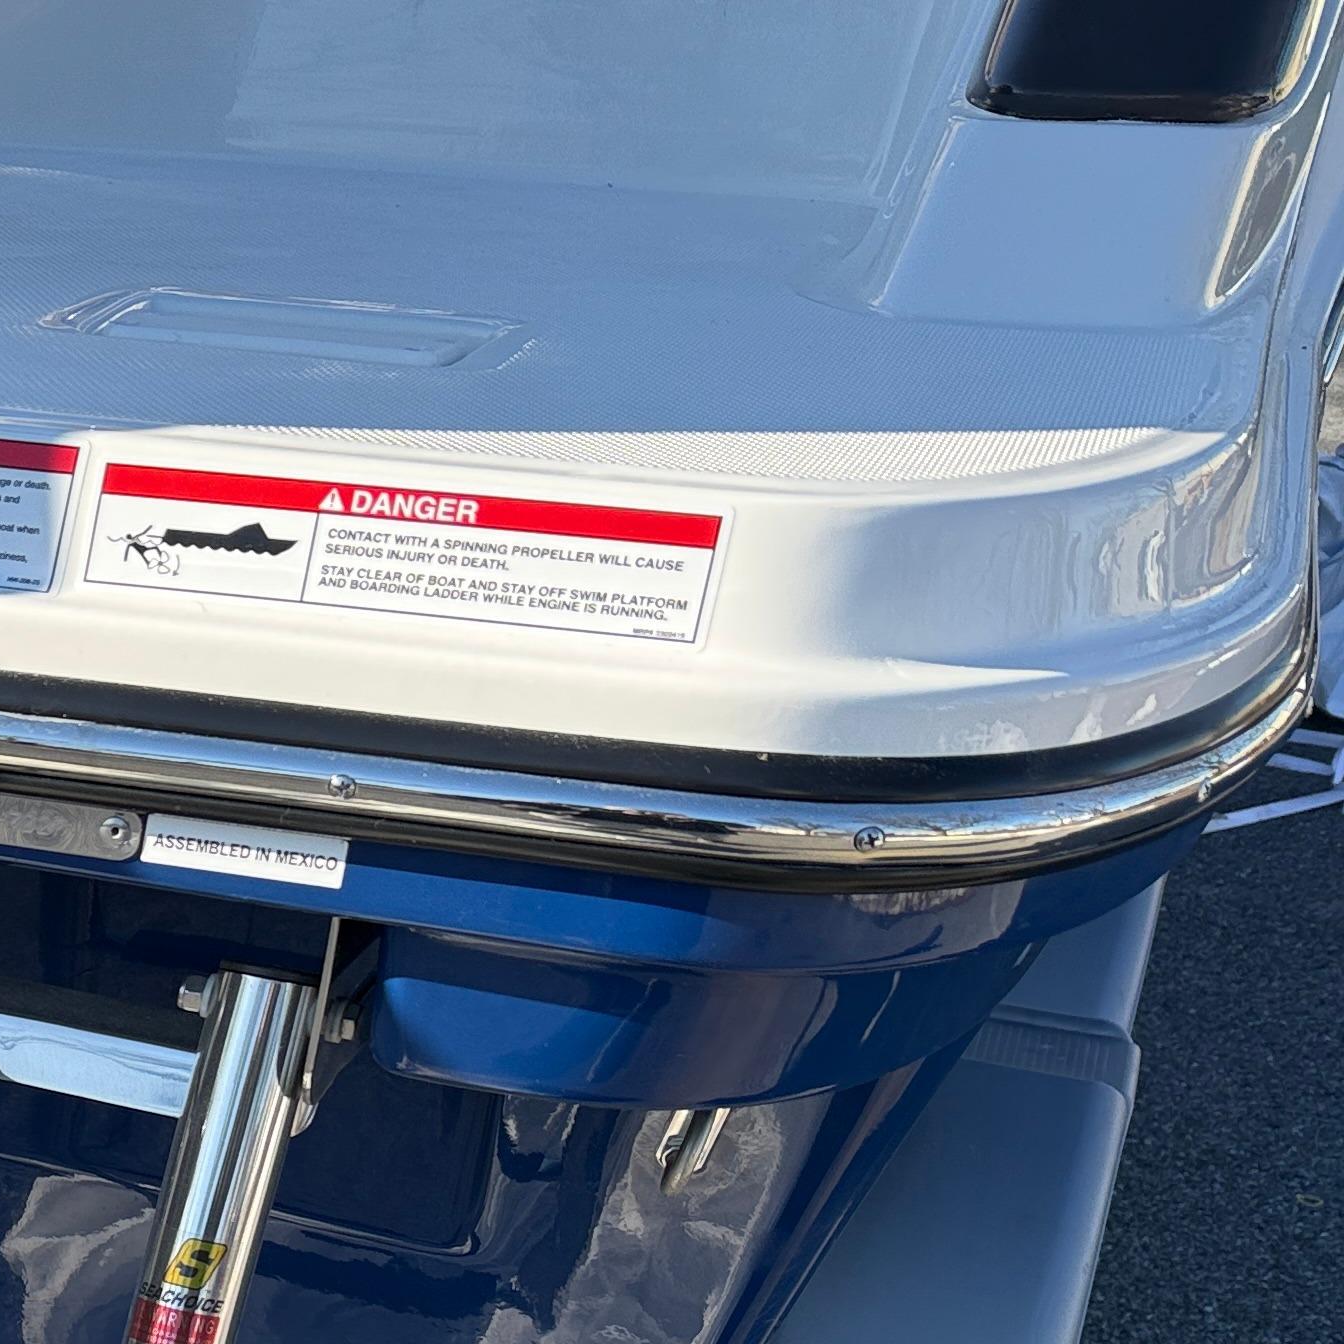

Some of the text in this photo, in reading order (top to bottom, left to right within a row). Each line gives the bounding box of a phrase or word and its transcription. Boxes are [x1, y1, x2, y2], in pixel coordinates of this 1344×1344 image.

[3, 495, 20, 504] and
[25, 480, 51, 490] death.
[350, 489, 480, 524] DANGER
[17, 525, 40, 535] when
[325, 544, 509, 571] SERIOUS INJURY OR DEATH.
[328, 528, 684, 572] CONTACT WITH A SPINNING PROPELLER WILL CAUSE
[318, 576, 668, 621] AND BOARDING LADDER WHILE ENGINE IS RUNNING.
[321, 565, 688, 610] STAY CLEAR OF BOAT AND STAY OFF SWIM PLATFORM
[153, 833, 338, 871] ASSEMBLED IN MEXICO
[139, 1282, 224, 1314] SEACHOICE
